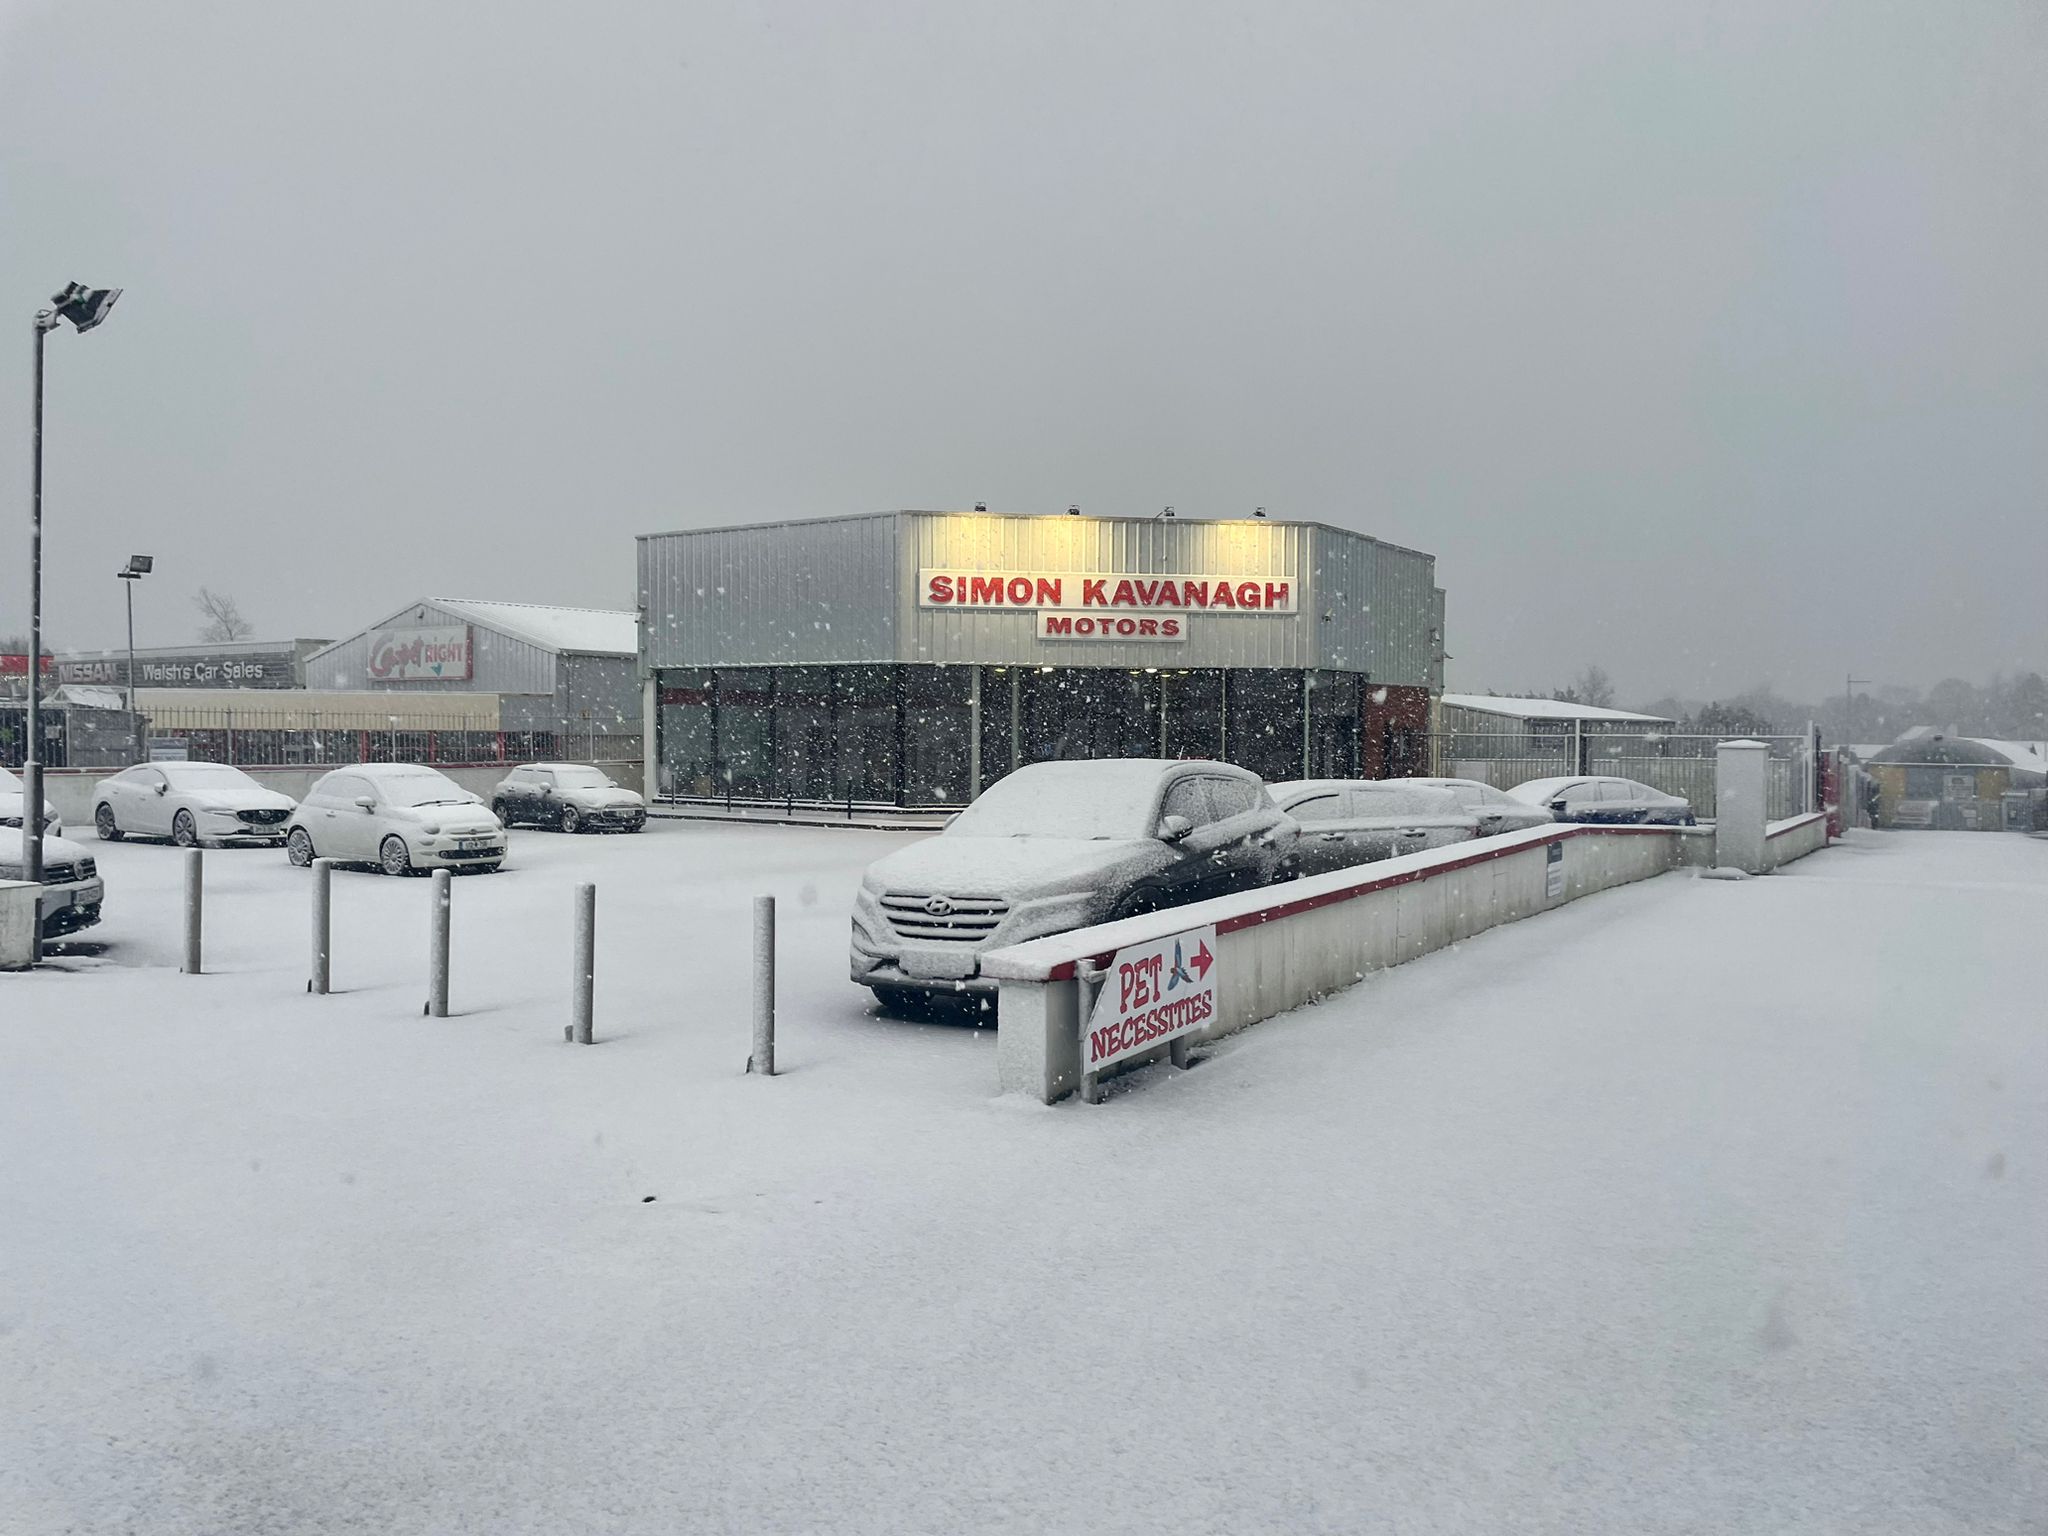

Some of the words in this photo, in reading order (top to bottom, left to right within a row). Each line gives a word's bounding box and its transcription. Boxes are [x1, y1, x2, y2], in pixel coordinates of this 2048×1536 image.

[929, 575, 1062, 606] SIMON
[1083, 578, 1290, 610] KAVANAGH
[1047, 617, 1180, 636] MOTORS
[425, 643, 464, 663] RIGHT
[59, 663, 117, 682] NISSAN
[143, 664, 192, 680] Walsh's
[194, 662, 218, 680] Car
[223, 661, 264, 679] Sales
[1119, 953, 1162, 1014] PET
[1090, 989, 1212, 1062] NECESSITIES
